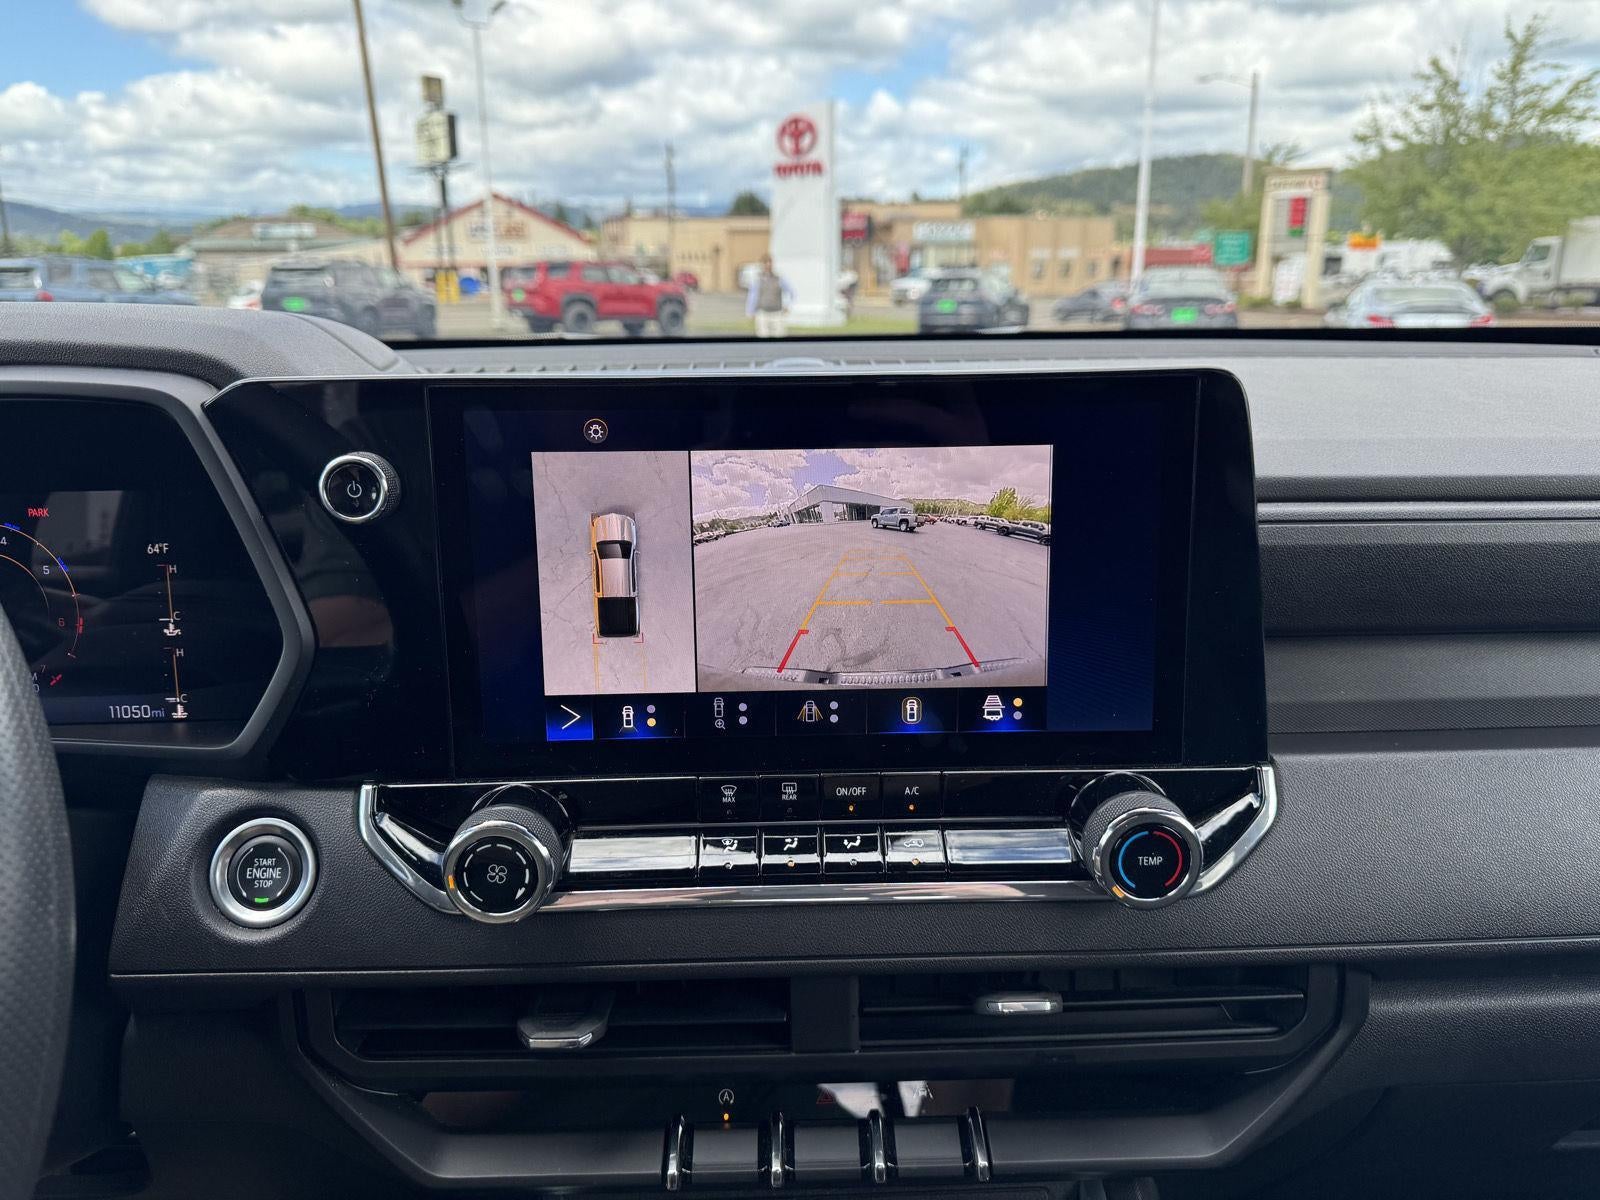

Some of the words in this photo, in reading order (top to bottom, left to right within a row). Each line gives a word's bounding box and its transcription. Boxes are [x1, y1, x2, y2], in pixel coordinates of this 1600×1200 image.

[28, 508, 49, 517] PARK
[0, 537, 7, 545] 4
[147, 543, 169, 554] 64°F
[43, 565, 50, 575] 5
[169, 564, 177, 573] H
[173, 611, 181, 621] C
[58, 618, 65, 627] 6
[176, 648, 184, 657] H
[180, 693, 188, 703] C
[108, 704, 151, 719] 11050
[836, 786, 867, 796] ON/OFF
[904, 786, 920, 795] A/C
[781, 793, 798, 801] REAR
[254, 857, 277, 867] START
[1137, 856, 1163, 866] TEMP
[246, 867, 283, 879] ENGINE
[254, 879, 273, 888] STOP
